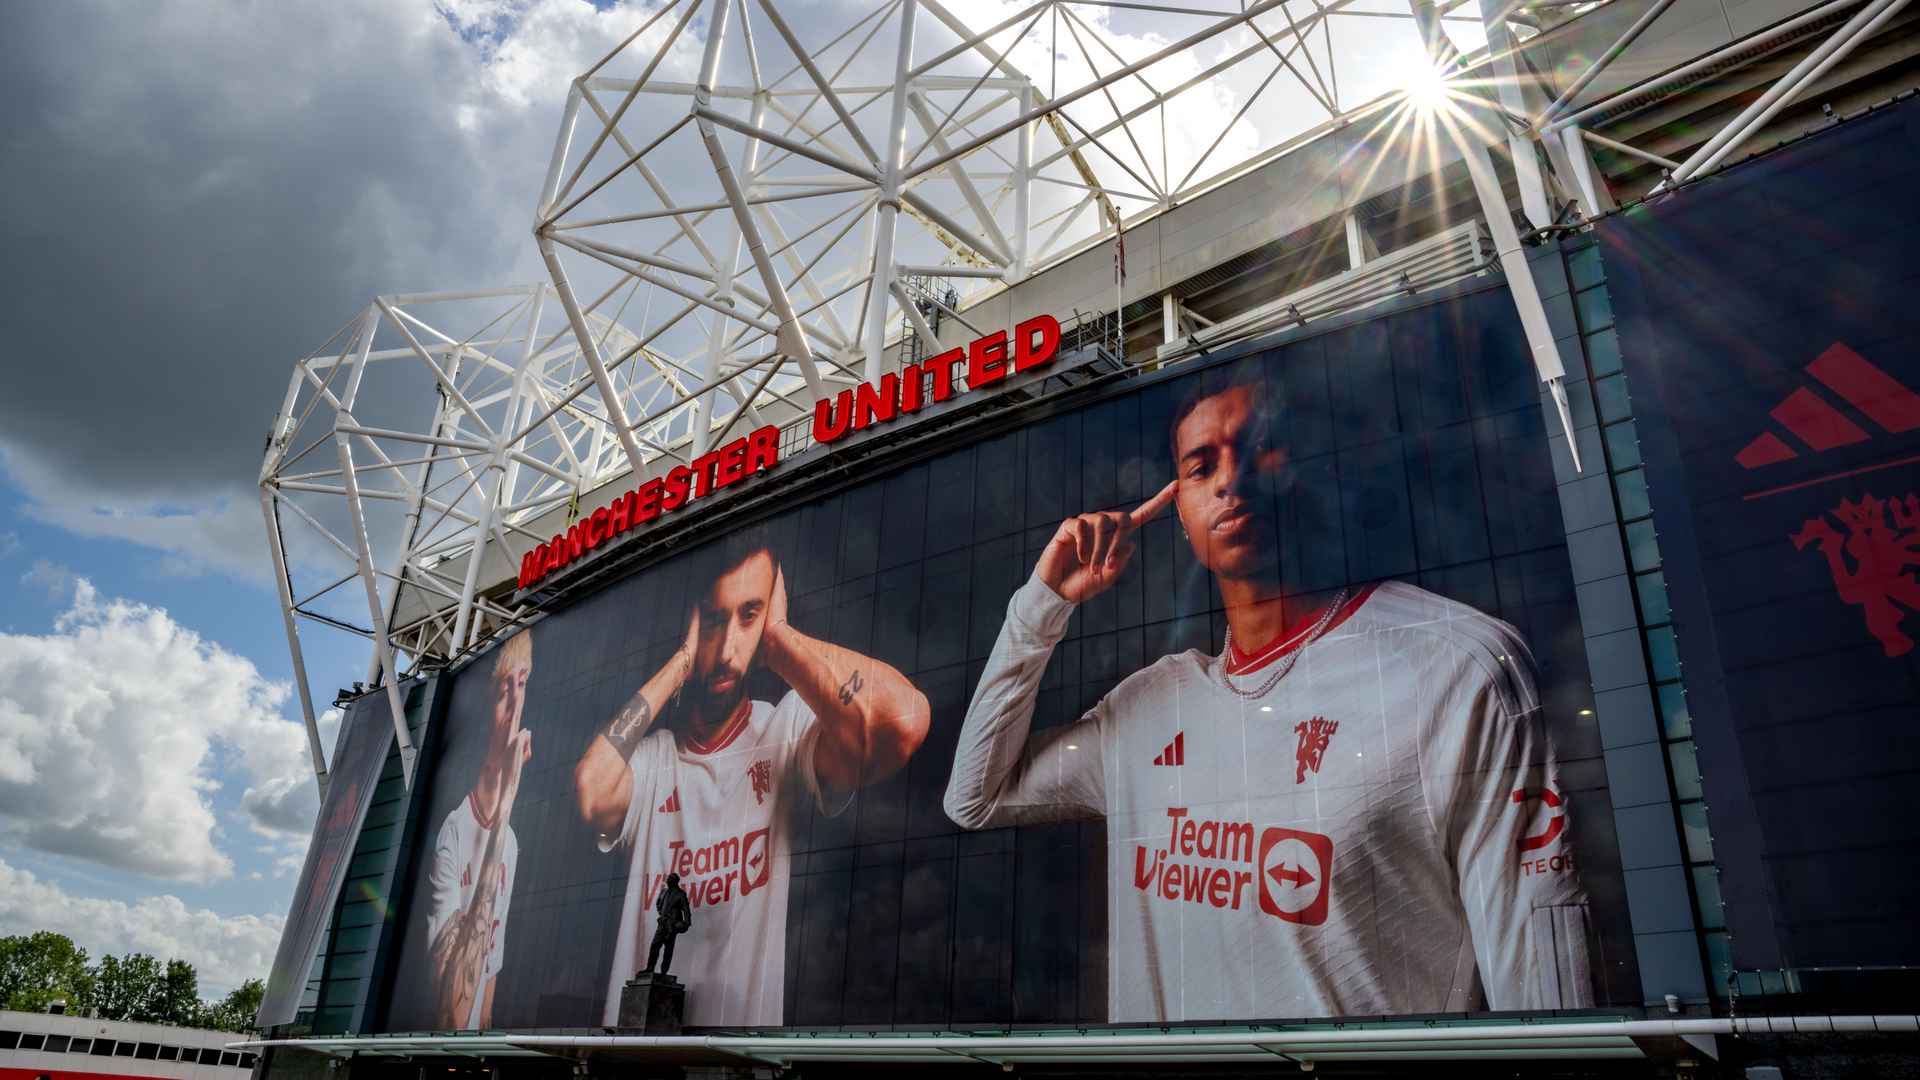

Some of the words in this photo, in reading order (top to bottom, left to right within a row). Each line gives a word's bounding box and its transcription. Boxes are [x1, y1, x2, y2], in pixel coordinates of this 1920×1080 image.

[517, 425, 781, 590] MANCHESTER
[813, 314, 1062, 443] UNITED
[668, 836, 739, 876] Team
[1167, 807, 1255, 864] Team
[642, 869, 738, 912] Vwer
[1134, 845, 1252, 911] Viewer
